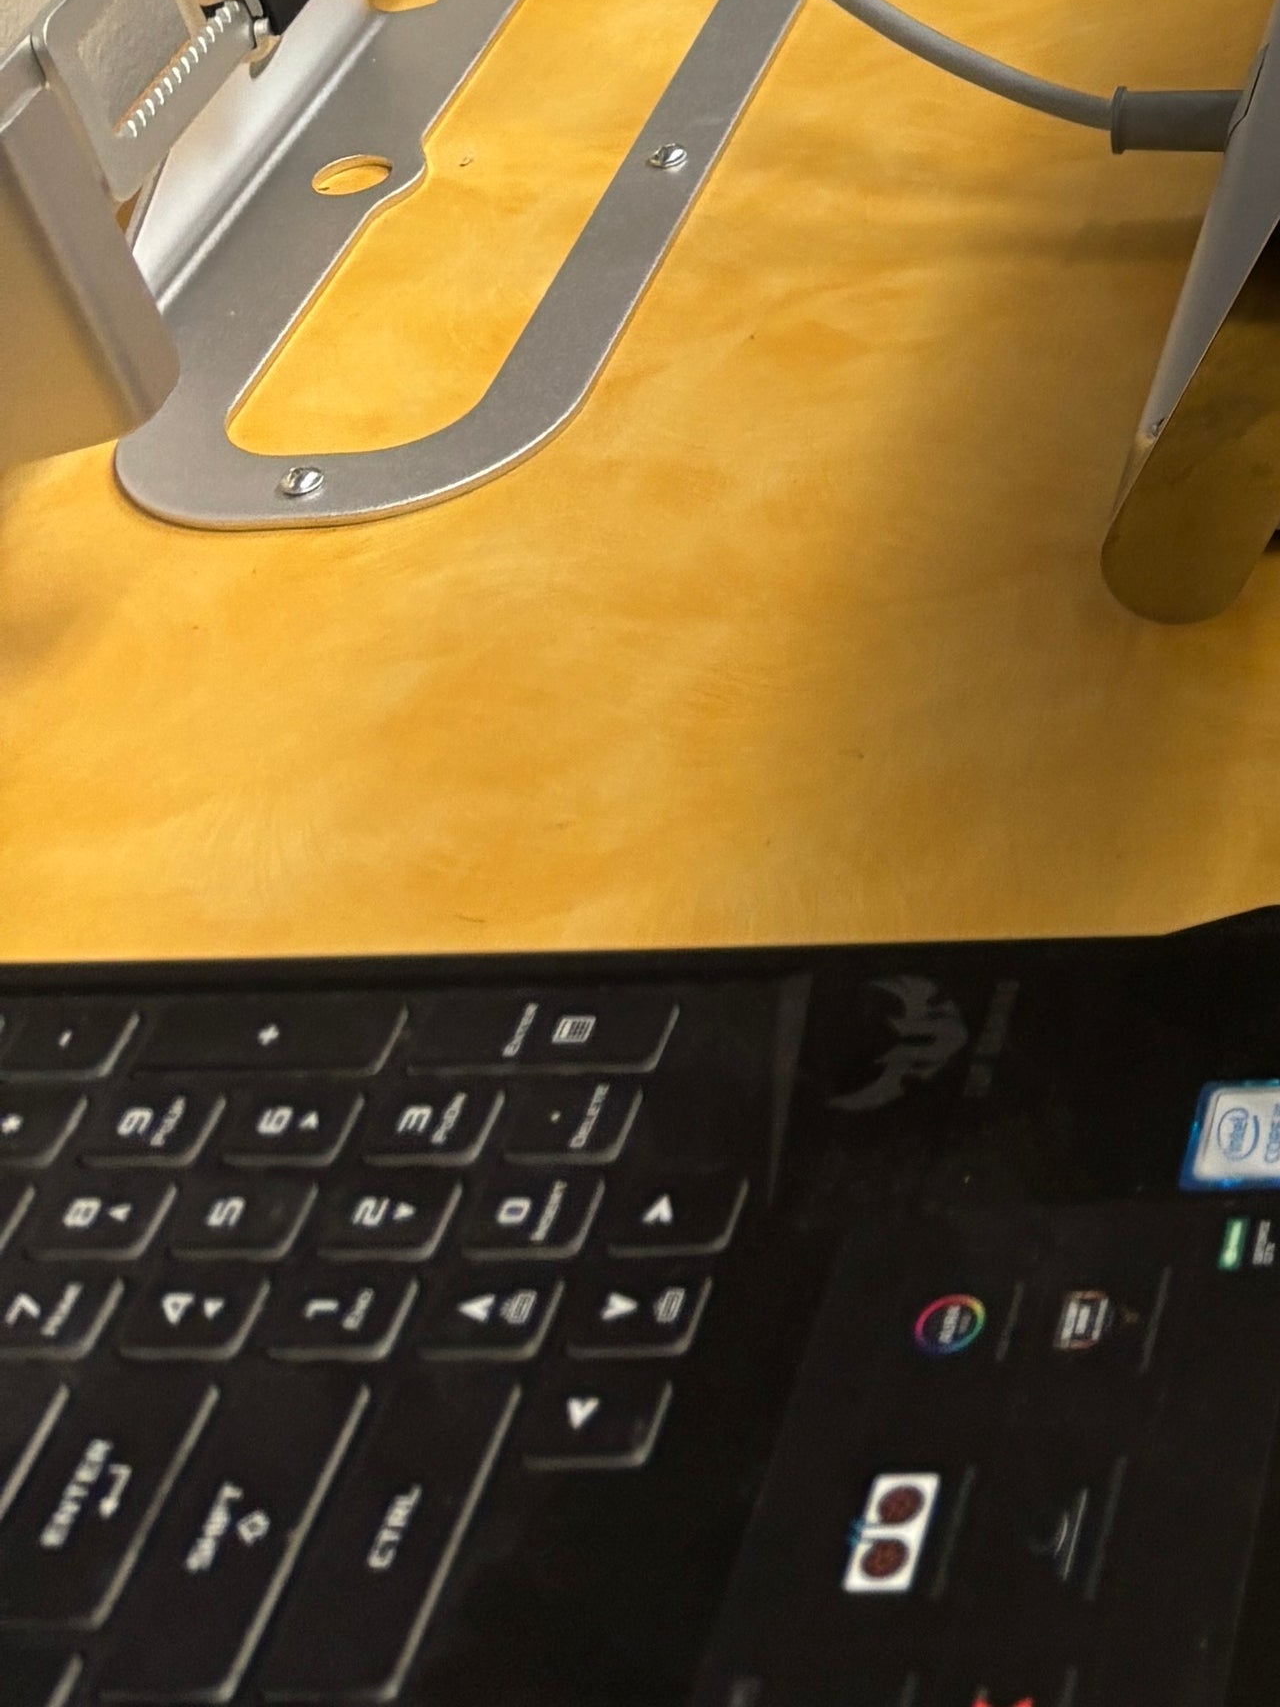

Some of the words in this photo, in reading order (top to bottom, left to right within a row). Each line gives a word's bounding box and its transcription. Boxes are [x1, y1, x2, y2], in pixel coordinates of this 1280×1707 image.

[117, 1106, 154, 1137] 9
[257, 1105, 294, 1135] 6
[397, 1104, 433, 1133] 3
[63, 1197, 101, 1229] 8
[206, 1196, 246, 1227] 5
[352, 1196, 390, 1228] 2
[366, 1485, 422, 1571] CTRL
